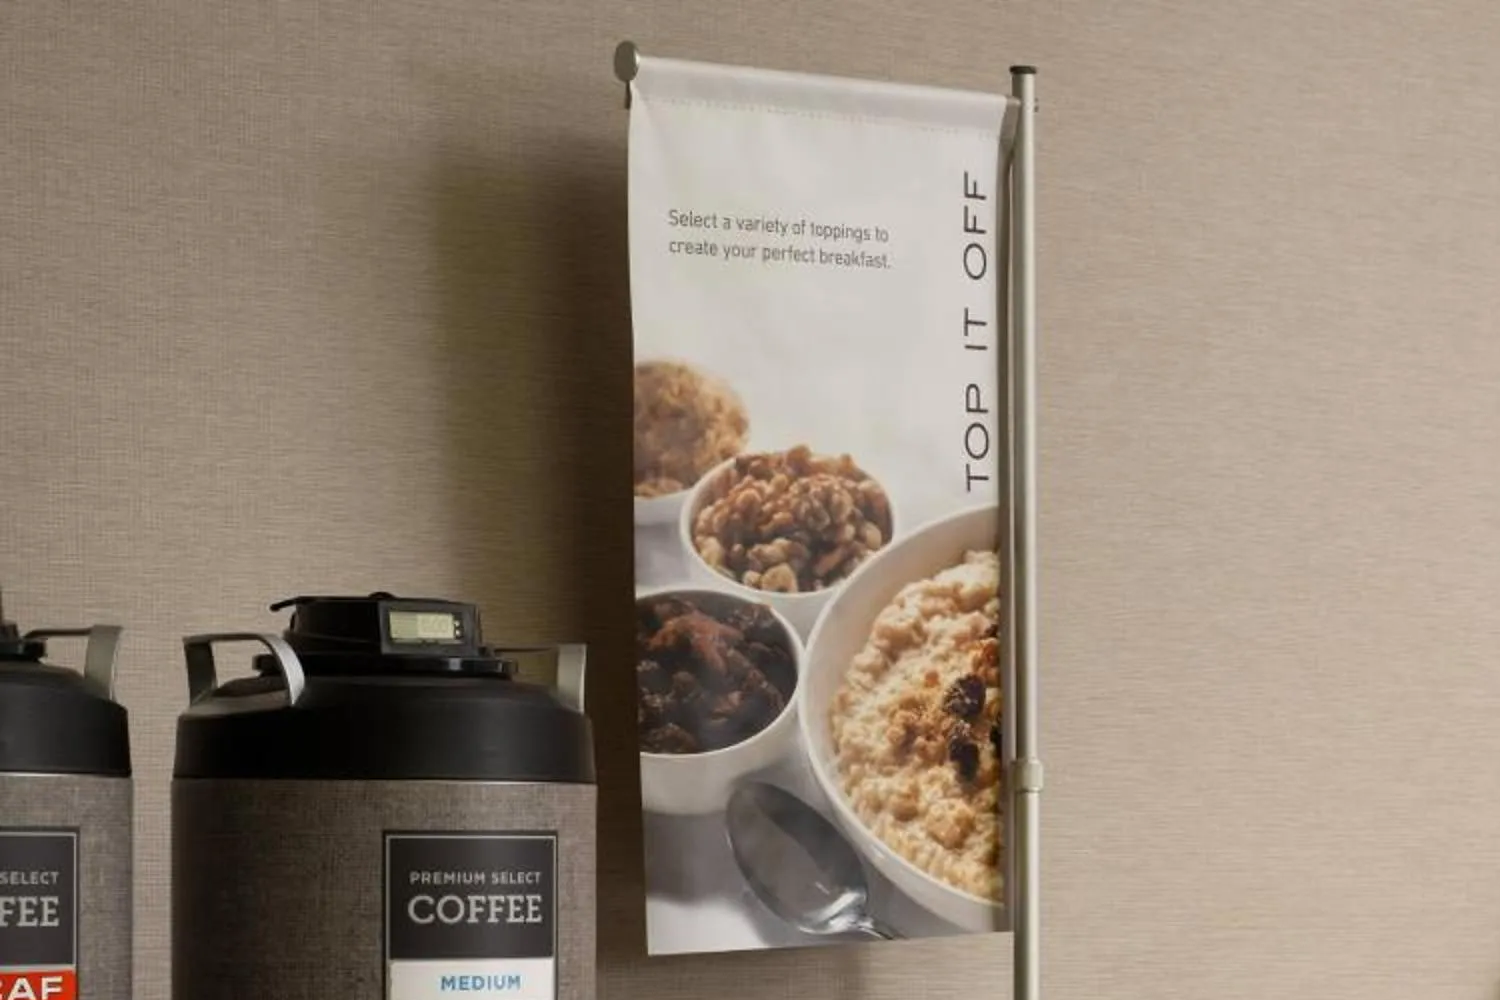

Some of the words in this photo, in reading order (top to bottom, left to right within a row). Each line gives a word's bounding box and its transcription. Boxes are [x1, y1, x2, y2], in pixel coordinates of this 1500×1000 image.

[668, 209, 717, 229] Select
[722, 216, 731, 231] a
[736, 217, 788, 237] variety
[792, 219, 806, 236] of
[811, 221, 871, 244] toppings
[875, 226, 889, 243] to
[962, 171, 987, 281] OFF
[668, 239, 717, 257] create
[723, 246, 757, 260] your
[762, 245, 816, 263] perfect
[819, 249, 891, 269] breakfast.
[963, 307, 988, 351] IT
[964, 382, 990, 492] TOP
[0, 871, 59, 885] SELECT
[409, 871, 485, 885] PREMIUM
[491, 871, 542, 884] SELECT
[407, 894, 543, 924] COFFEE
[440, 975, 521, 991] MEDIUM
